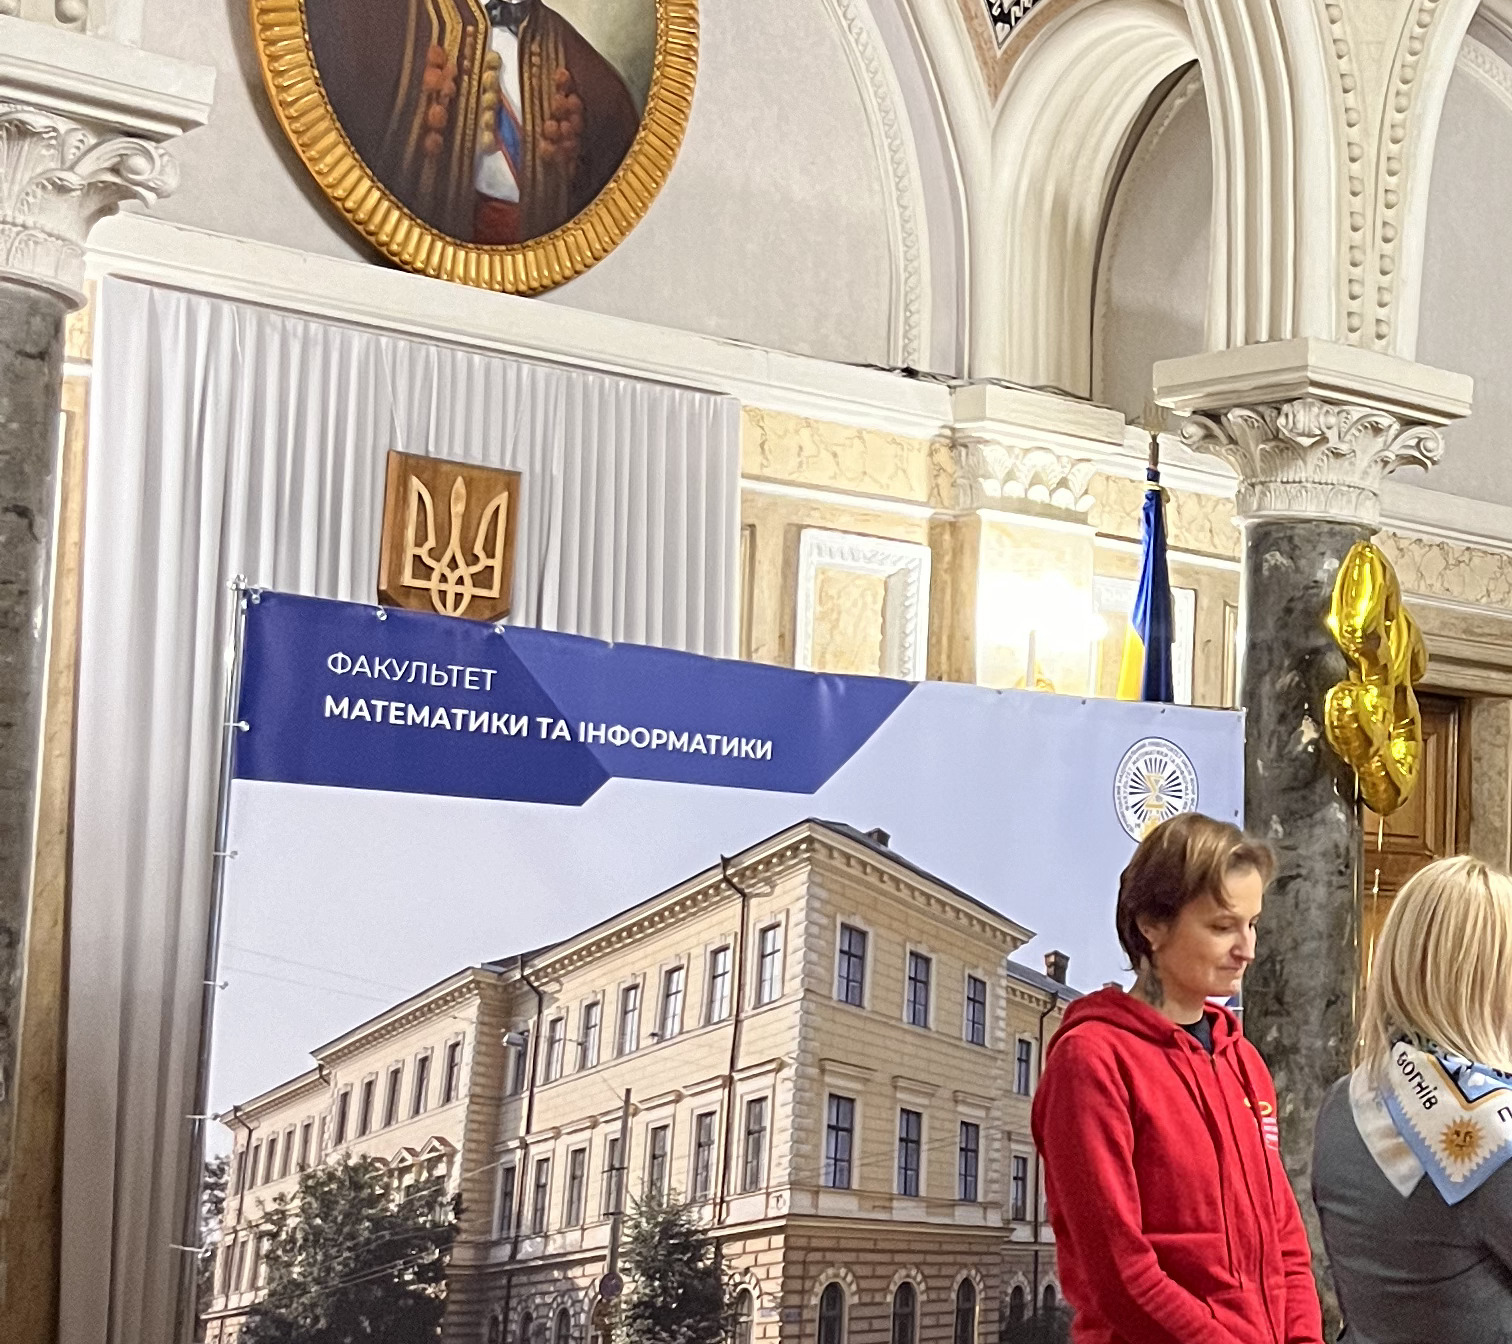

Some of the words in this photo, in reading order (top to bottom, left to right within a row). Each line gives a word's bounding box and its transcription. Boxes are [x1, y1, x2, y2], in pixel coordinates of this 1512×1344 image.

[327, 652, 498, 691] ФАКУЛЬТЕТ
[324, 694, 529, 737] МАТЕМАТИКИ
[536, 716, 571, 741] ТА
[578, 721, 773, 760] ІНФОРМАТИКИ
